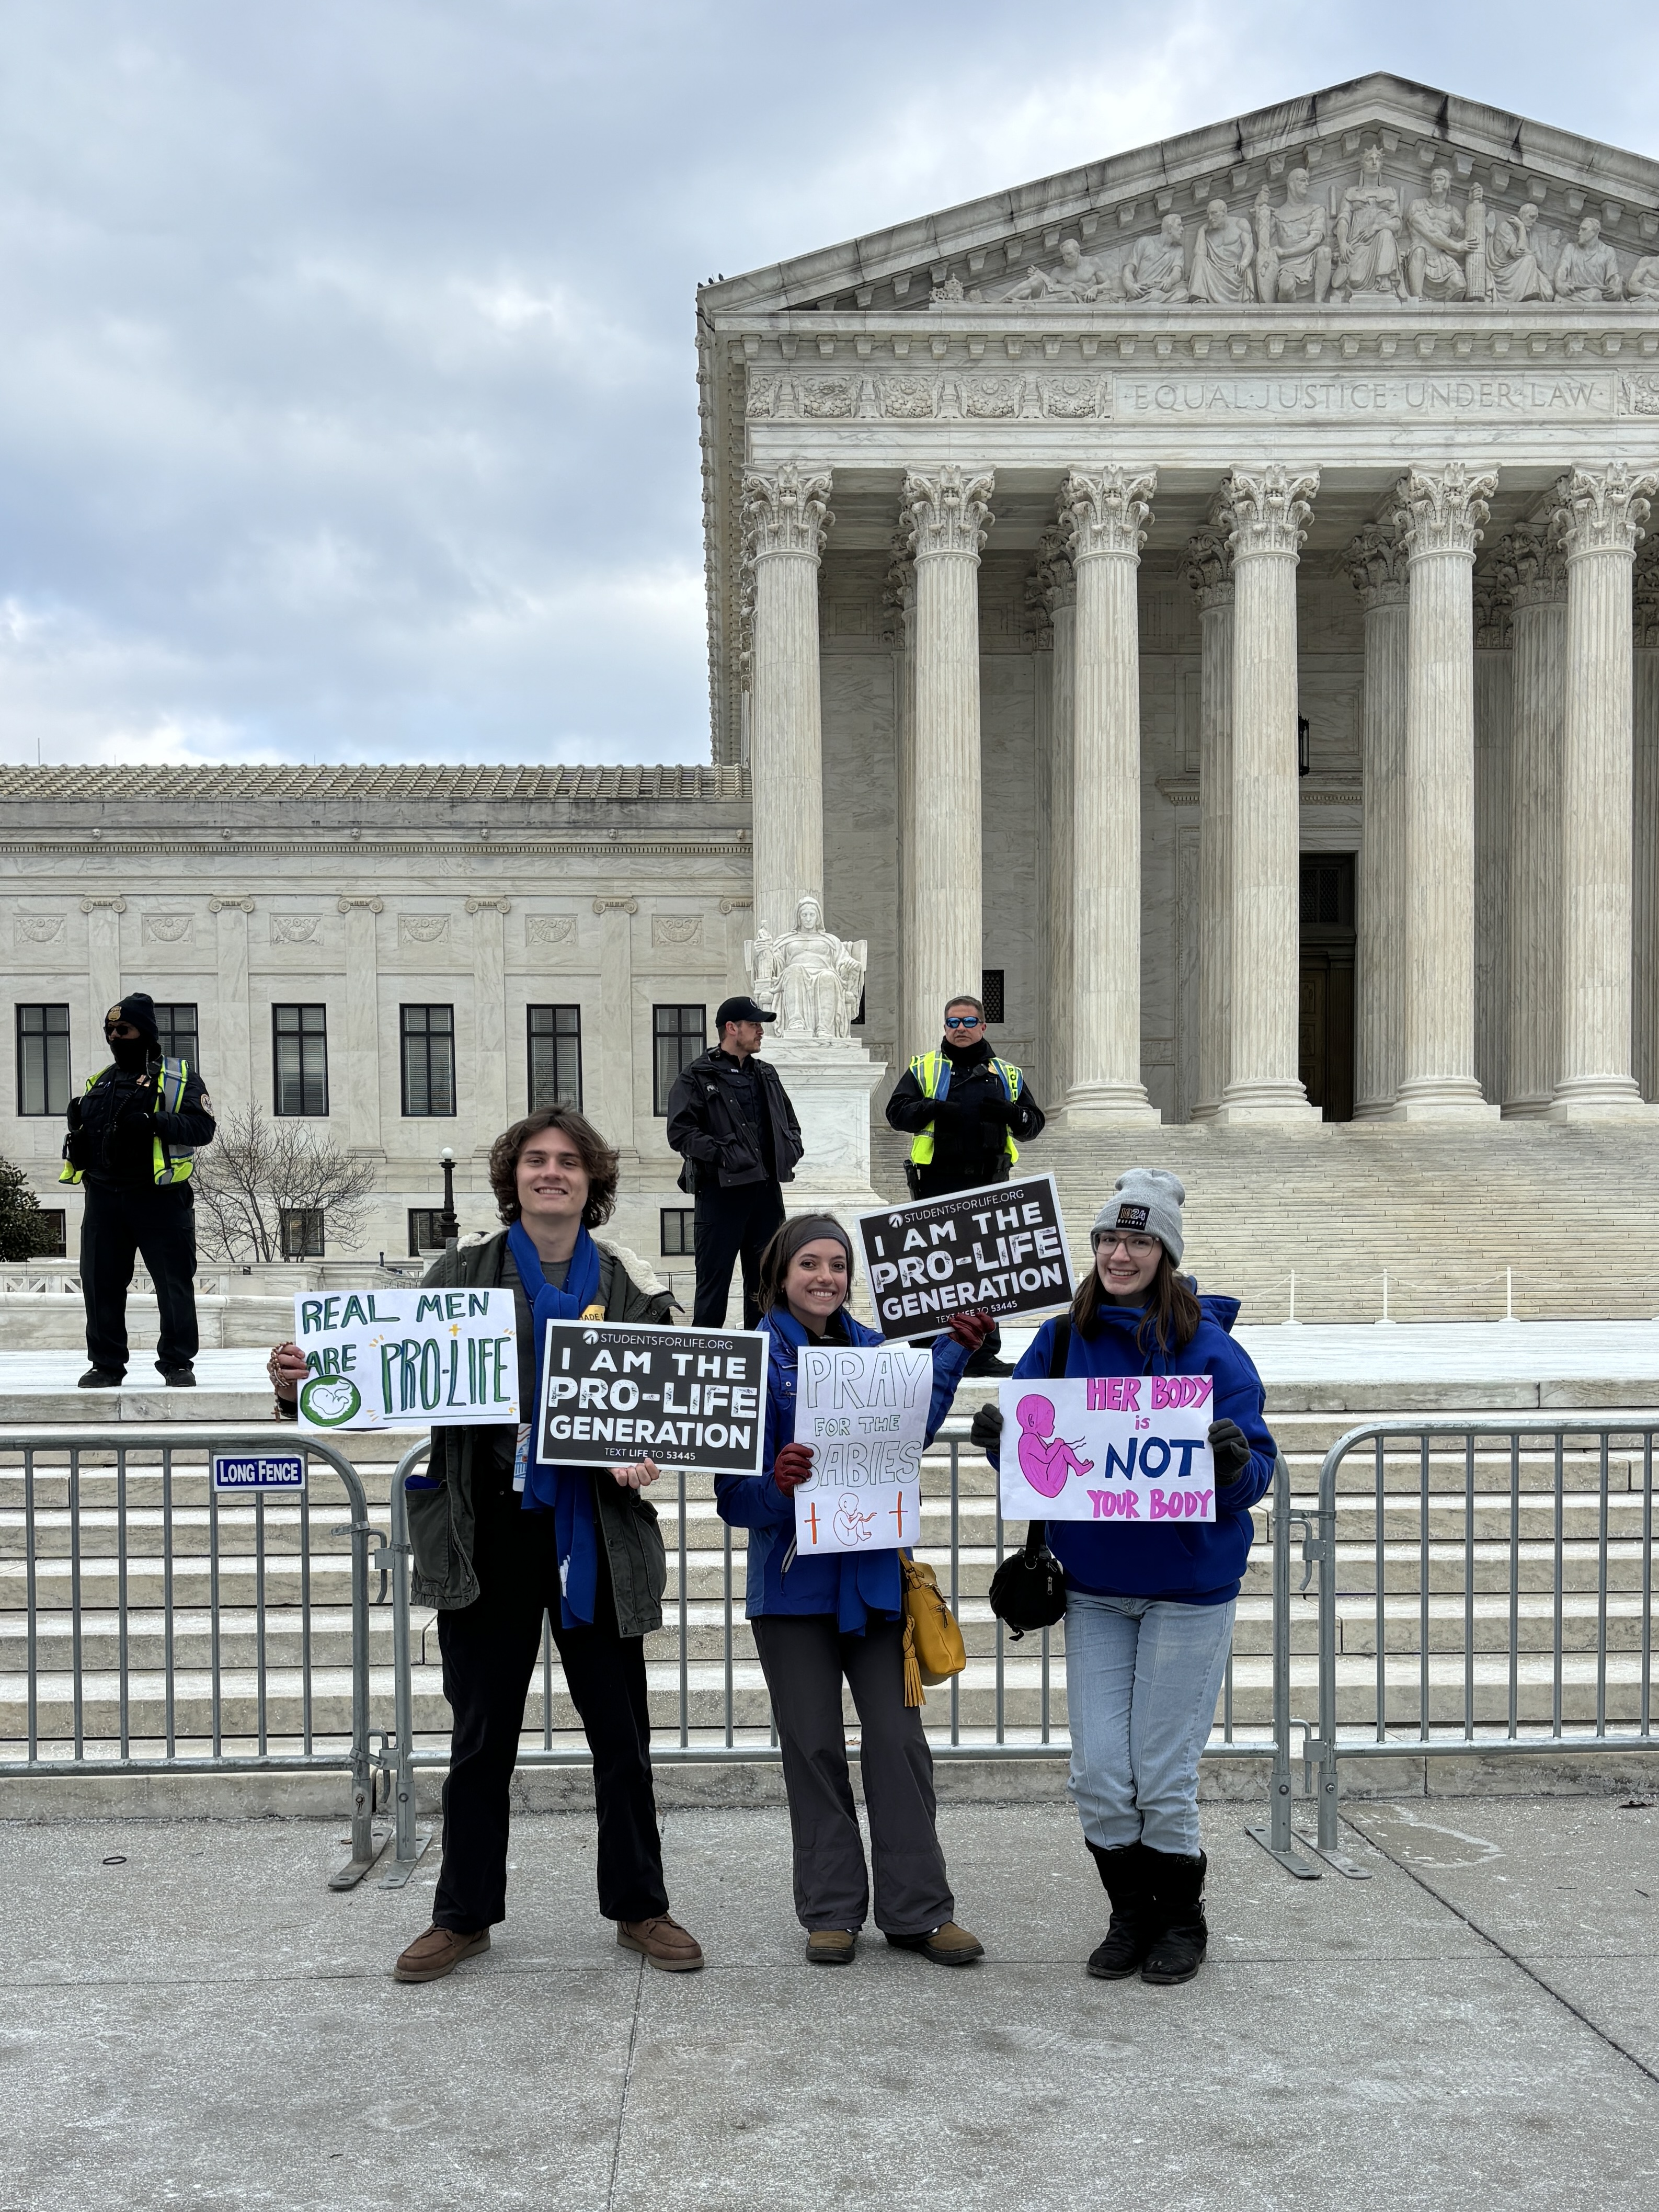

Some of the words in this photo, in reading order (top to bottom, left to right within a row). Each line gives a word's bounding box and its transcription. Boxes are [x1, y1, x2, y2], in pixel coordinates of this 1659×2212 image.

[1134, 384, 1248, 412] EQUAL
[1255, 383, 1387, 409] JUSTICE
[1405, 382, 1517, 408] UNDER
[1530, 382, 1598, 407] LAW
[1009, 1067, 1017, 1102] POLI
[905, 1189, 1024, 1223] STUDENTSFORLIFE.ORG
[1120, 1208, 1146, 1221] 1024
[875, 1235, 885, 1257] I
[903, 1220, 957, 1252] AM
[972, 1201, 1043, 1235] THE
[871, 1226, 1061, 1293] PRO-LIFE
[883, 1262, 1063, 1320] GENERATION
[991, 1300, 1017, 1312] 53445
[302, 1295, 400, 1335] REAL
[416, 1292, 489, 1322] MEN
[601, 1333, 733, 1350] STUDENTSFORLIFE.ORG
[306, 1344, 357, 1376] ARE
[381, 1337, 511, 1414] PRO-LIFE
[562, 1347, 570, 1370] I
[590, 1349, 651, 1374] AM
[672, 1353, 746, 1379] THE
[805, 1351, 930, 1409] PRAY
[548, 1376, 757, 1419] PRO-LIFE
[1086, 1377, 1141, 1412] HER
[1151, 1375, 1214, 1410] BODY
[550, 1415, 751, 1450] GENERATION
[814, 1417, 851, 1437] FOR
[859, 1415, 900, 1434] THE
[1135, 1415, 1151, 1430] is
[604, 1447, 627, 1457] TEXT
[629, 1449, 648, 1458] LIFE
[651, 1450, 663, 1458] TO
[666, 1451, 696, 1460] 53445
[1105, 1436, 1205, 1480] NOT
[220, 1461, 255, 1483] LONG
[258, 1460, 298, 1481] FENCE
[1086, 1489, 1140, 1519] YOUR
[1150, 1489, 1214, 1519] BODY
